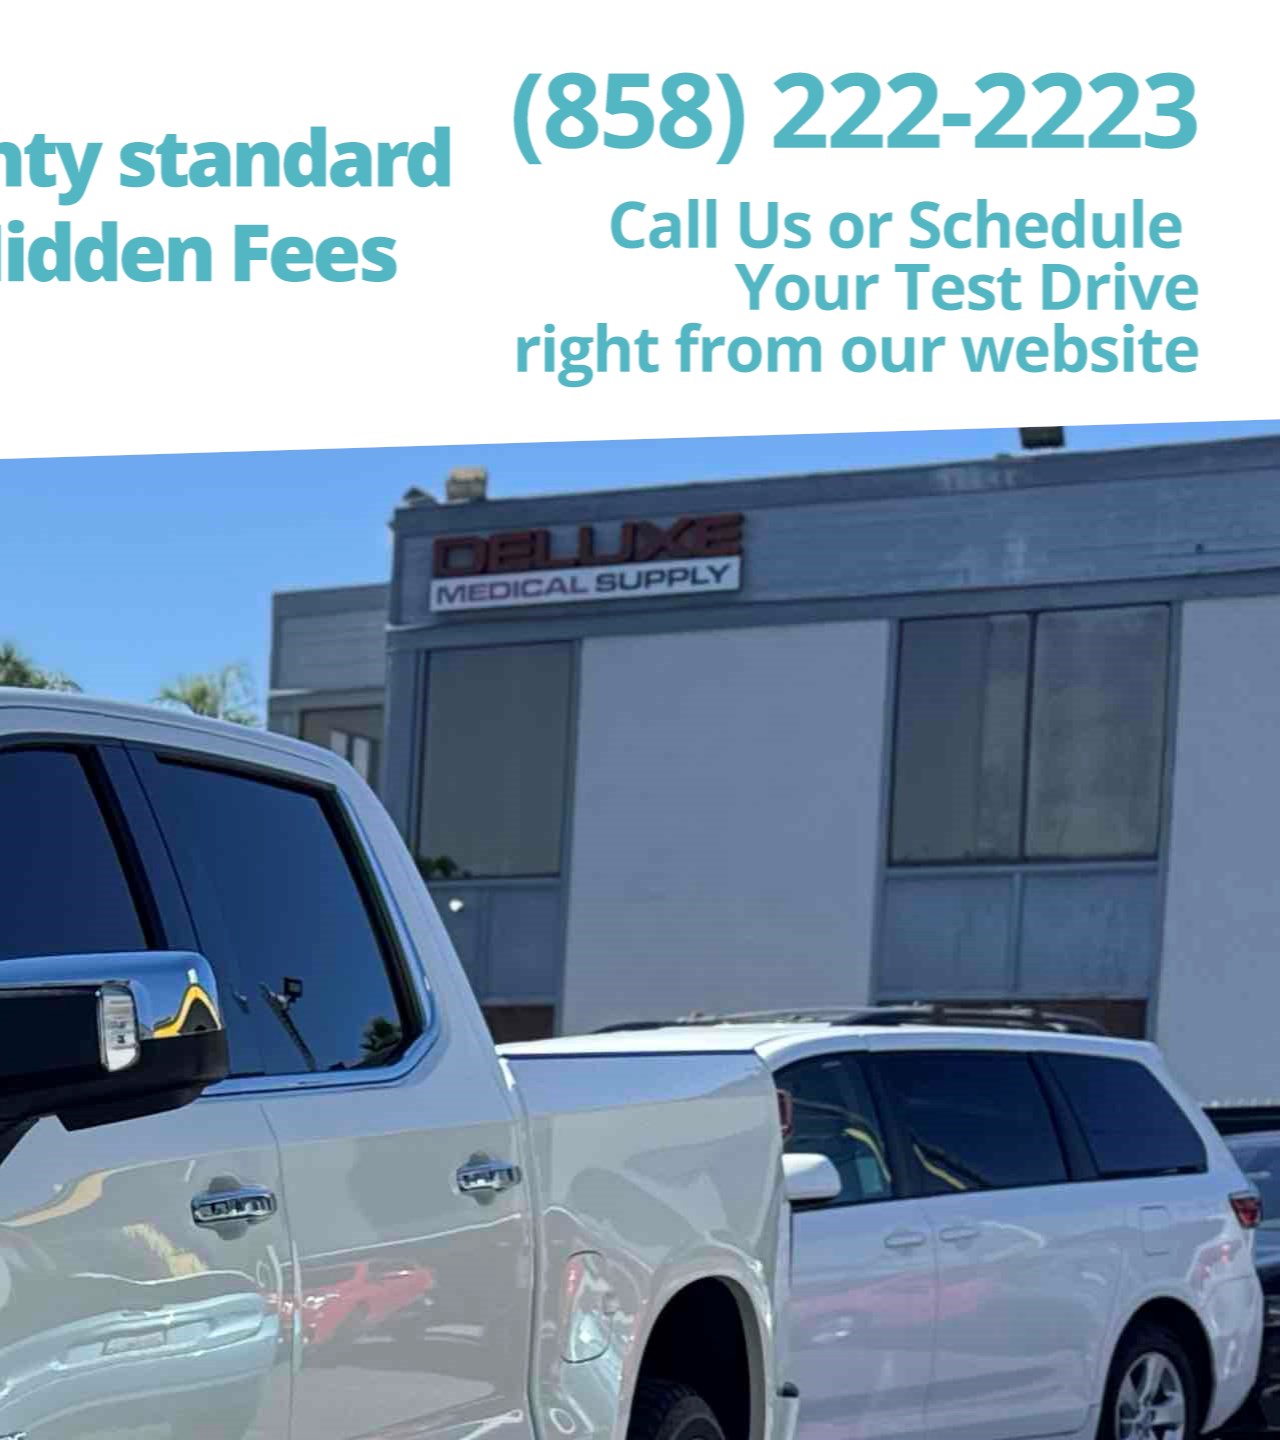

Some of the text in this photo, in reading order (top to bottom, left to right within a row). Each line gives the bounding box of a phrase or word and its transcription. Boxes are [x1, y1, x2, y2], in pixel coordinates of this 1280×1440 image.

[433, 513, 744, 577] DELUXE
[438, 563, 731, 605] MEDICAL SUPPLY
